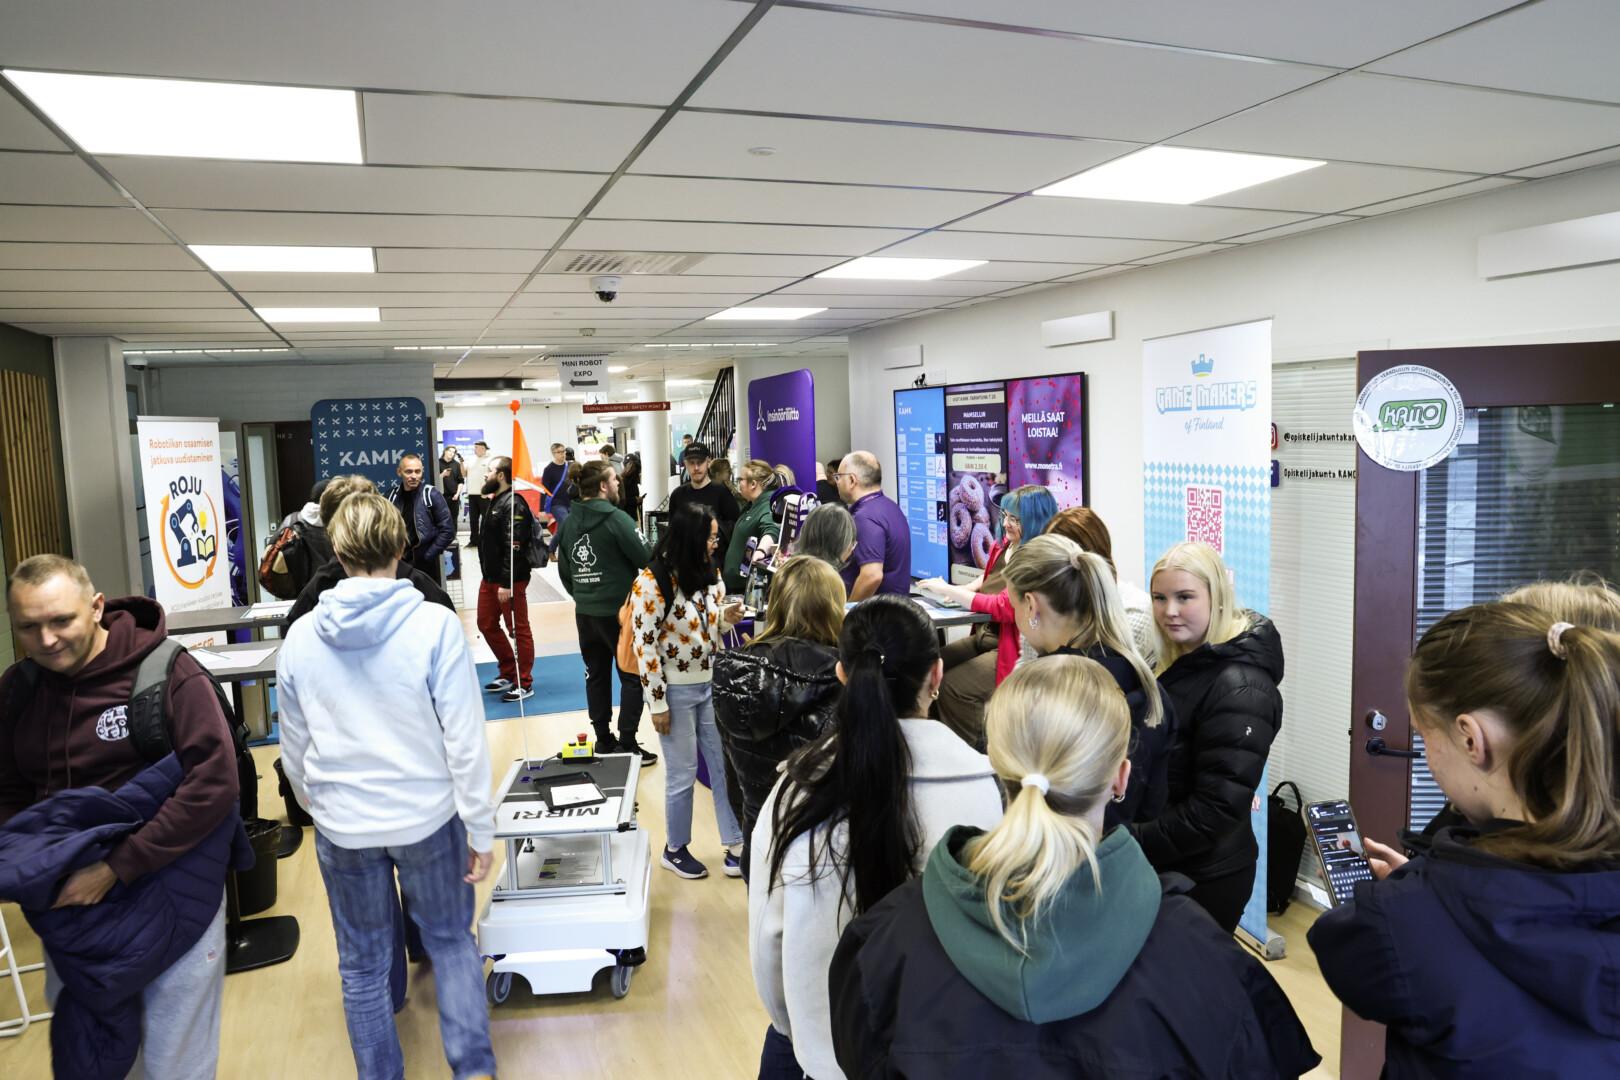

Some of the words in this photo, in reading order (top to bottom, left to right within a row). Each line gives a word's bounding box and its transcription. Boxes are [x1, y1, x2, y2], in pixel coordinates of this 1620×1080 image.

[579, 359, 603, 367] ROBOT
[1156, 385, 1193, 414] GAME
[1196, 381, 1257, 411] MAKERS
[767, 407, 799, 422] Insinööriliitto
[1021, 411, 1046, 423] MEILLÄ
[1046, 411, 1065, 422] SAAT
[1383, 404, 1440, 427] KAMO
[1193, 416, 1224, 432] Finland
[1027, 427, 1059, 437] LOISTAA!
[339, 449, 405, 467] KAMK
[1024, 462, 1063, 471] www.monetra.fi
[1283, 468, 1336, 480] Opiskelijakunta
[169, 475, 202, 500] ROJU
